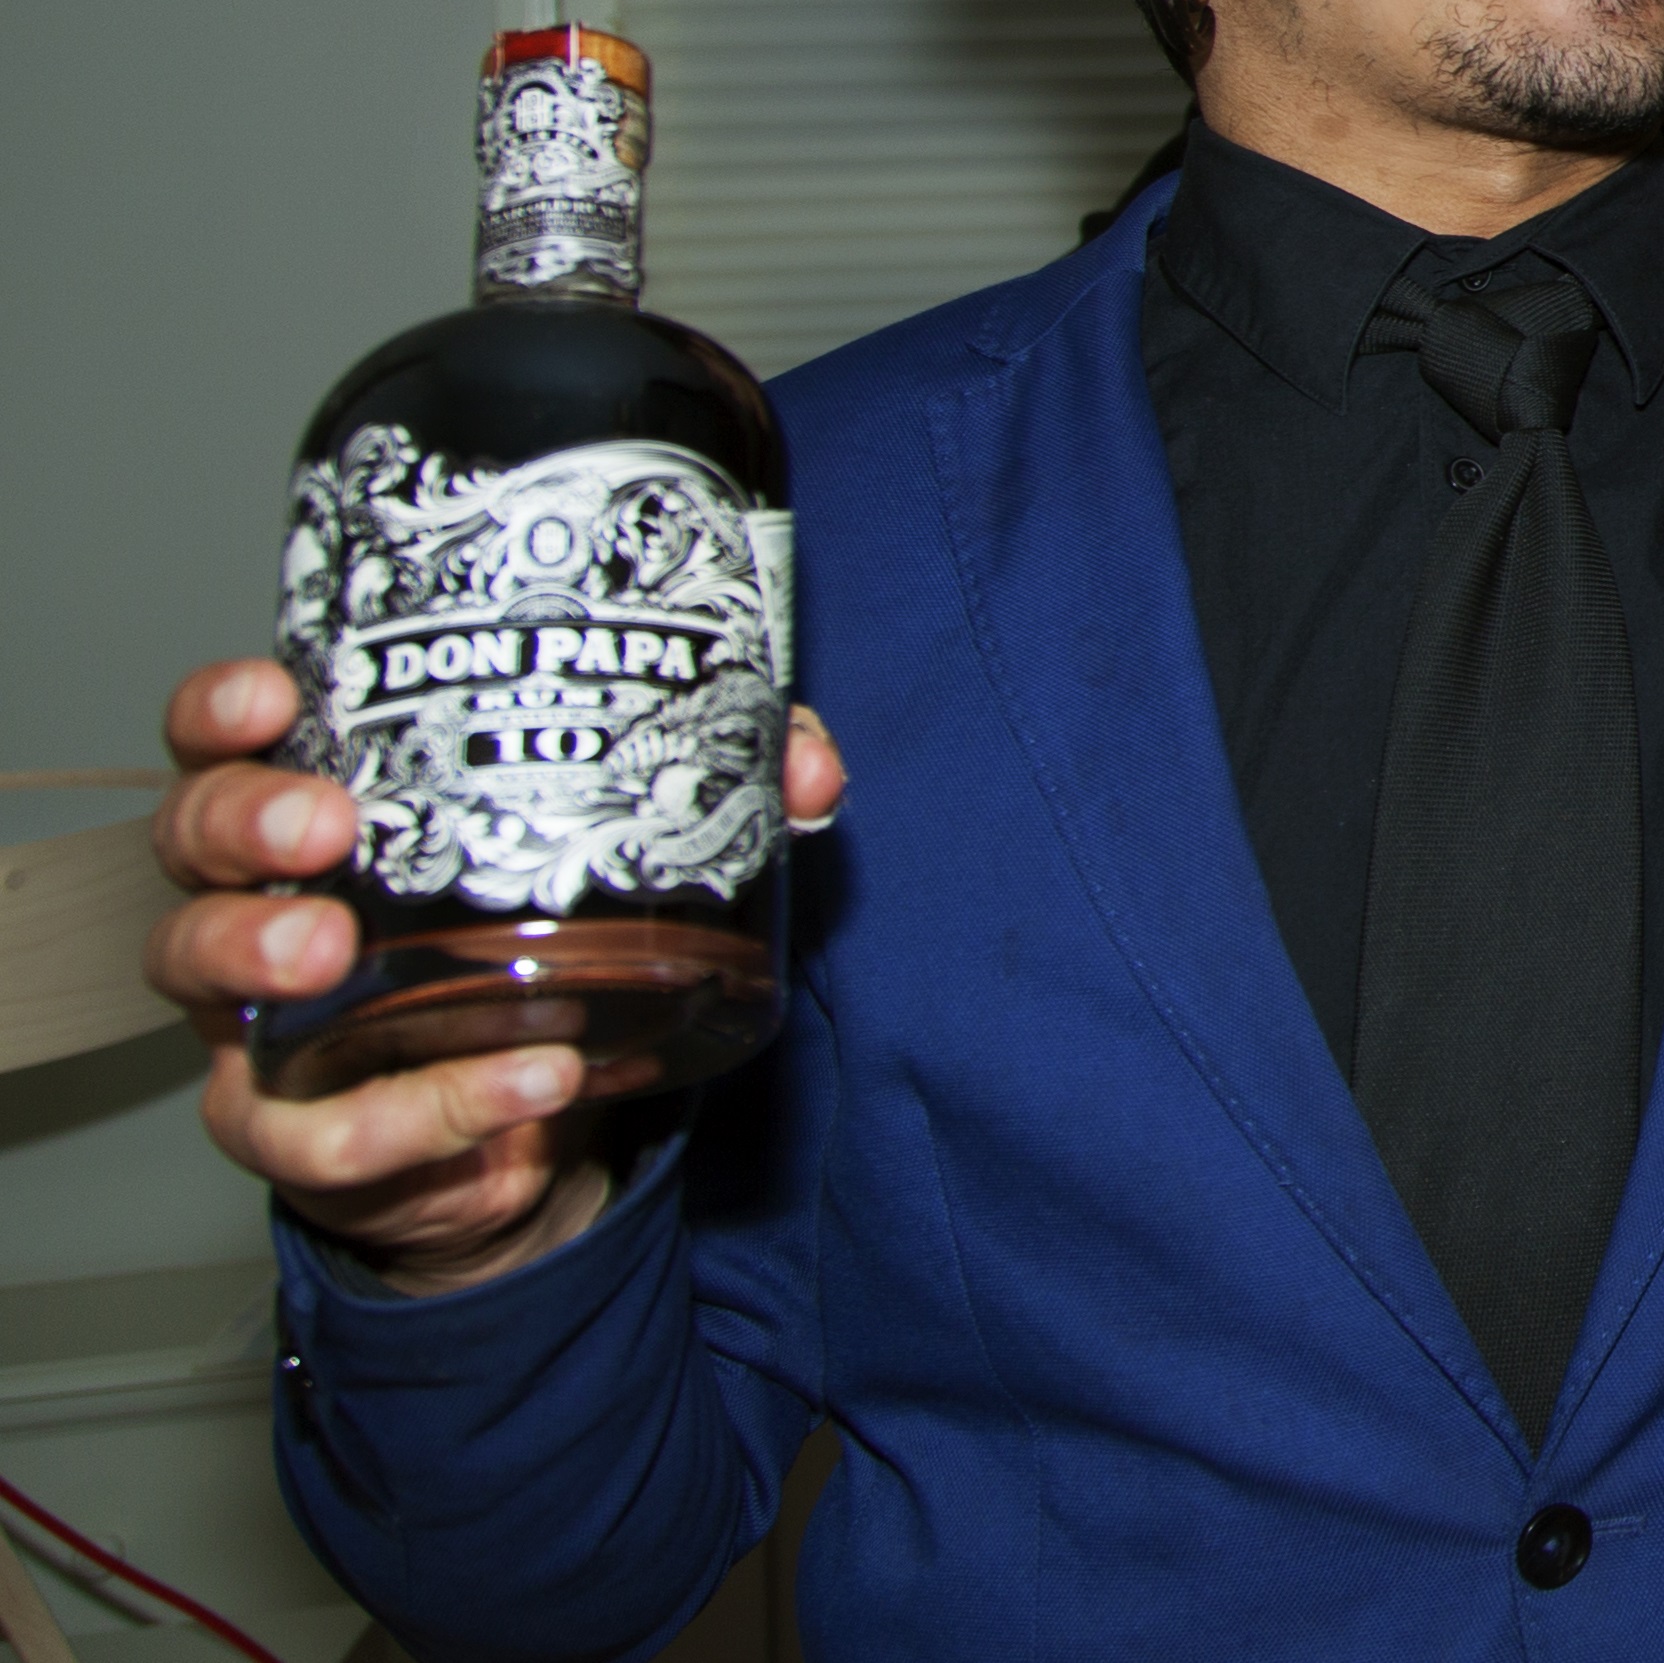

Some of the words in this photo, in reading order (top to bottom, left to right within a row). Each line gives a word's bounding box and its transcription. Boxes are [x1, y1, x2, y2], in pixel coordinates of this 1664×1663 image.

[384, 629, 523, 691] DON
[535, 626, 698, 681] PAPA
[492, 727, 603, 764] 10
